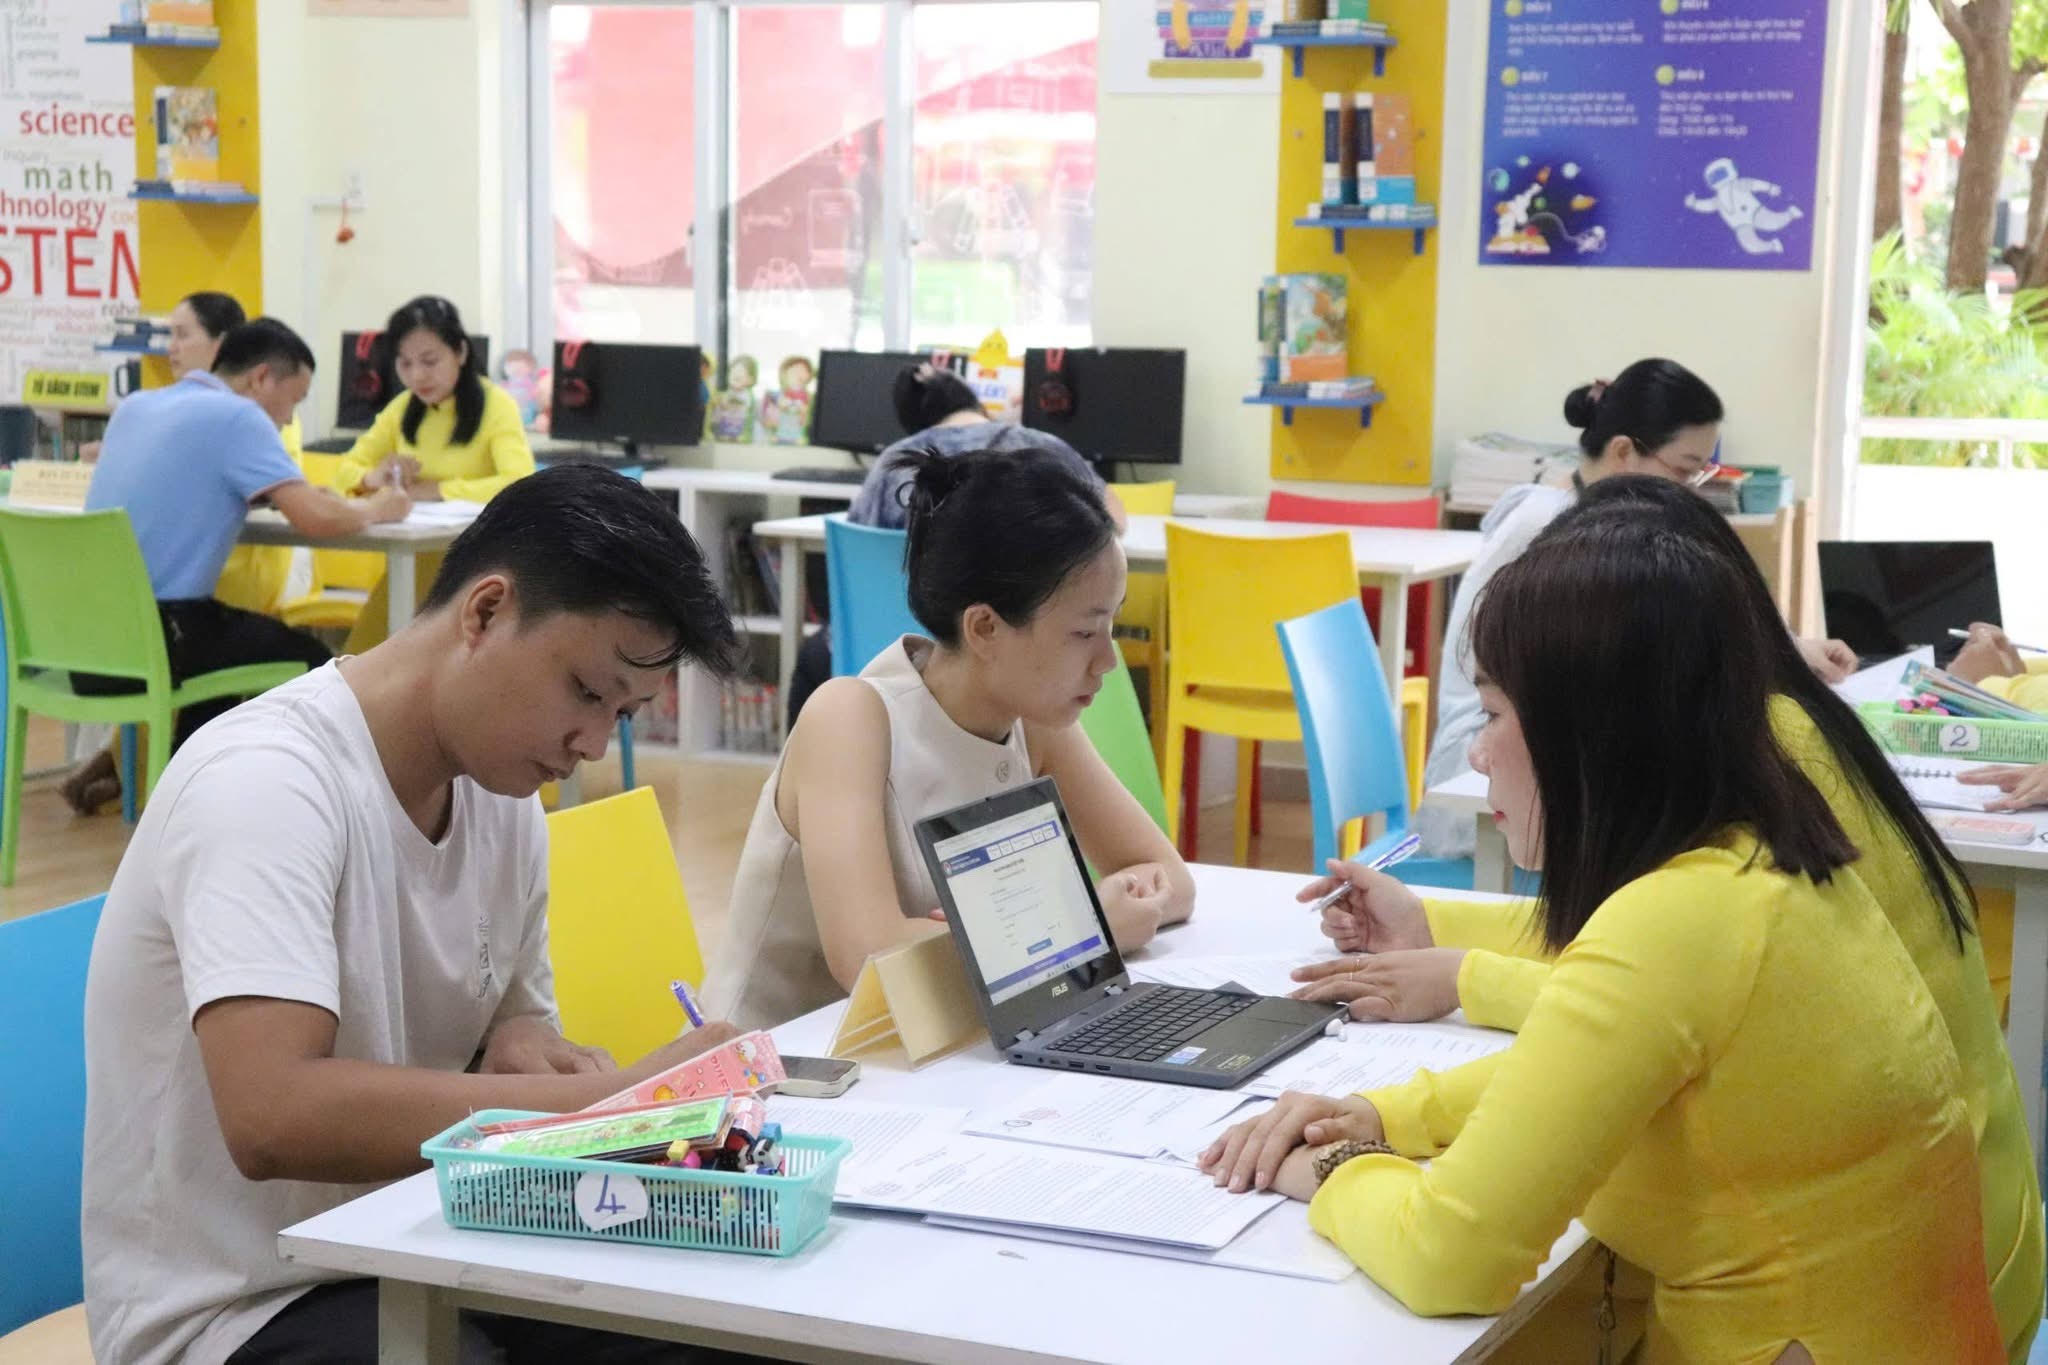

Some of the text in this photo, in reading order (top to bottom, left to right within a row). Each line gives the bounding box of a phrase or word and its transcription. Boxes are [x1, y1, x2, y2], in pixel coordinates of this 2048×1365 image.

[19, 103, 134, 137] science
[25, 160, 112, 192] math
[1950, 724, 1970, 747] 2
[1051, 982, 1069, 999] ASUS
[594, 1174, 627, 1215] 4
